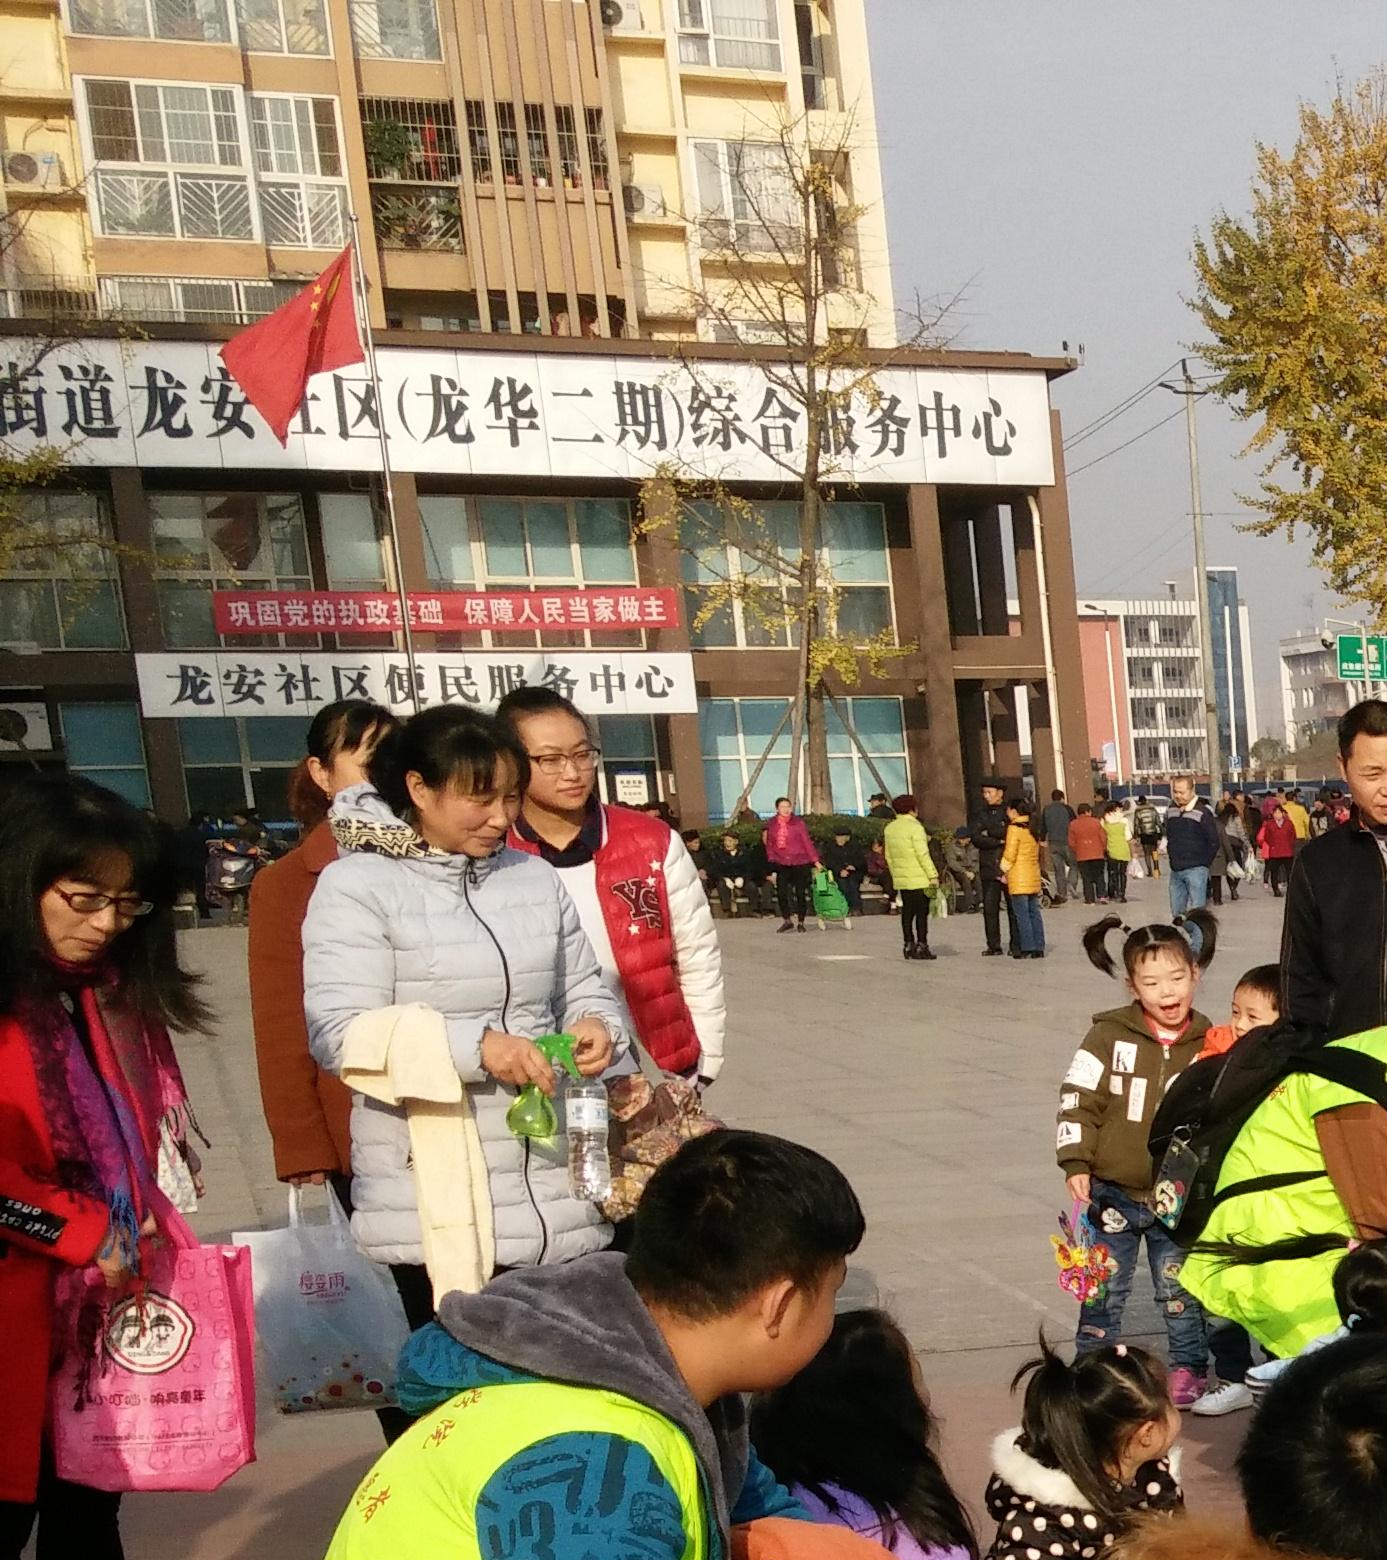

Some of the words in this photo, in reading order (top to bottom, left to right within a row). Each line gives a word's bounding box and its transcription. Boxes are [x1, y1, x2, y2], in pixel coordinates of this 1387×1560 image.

[228, 597, 444, 628] 巩固党的执政基础
[464, 596, 668, 625] 保障人民当家做主
